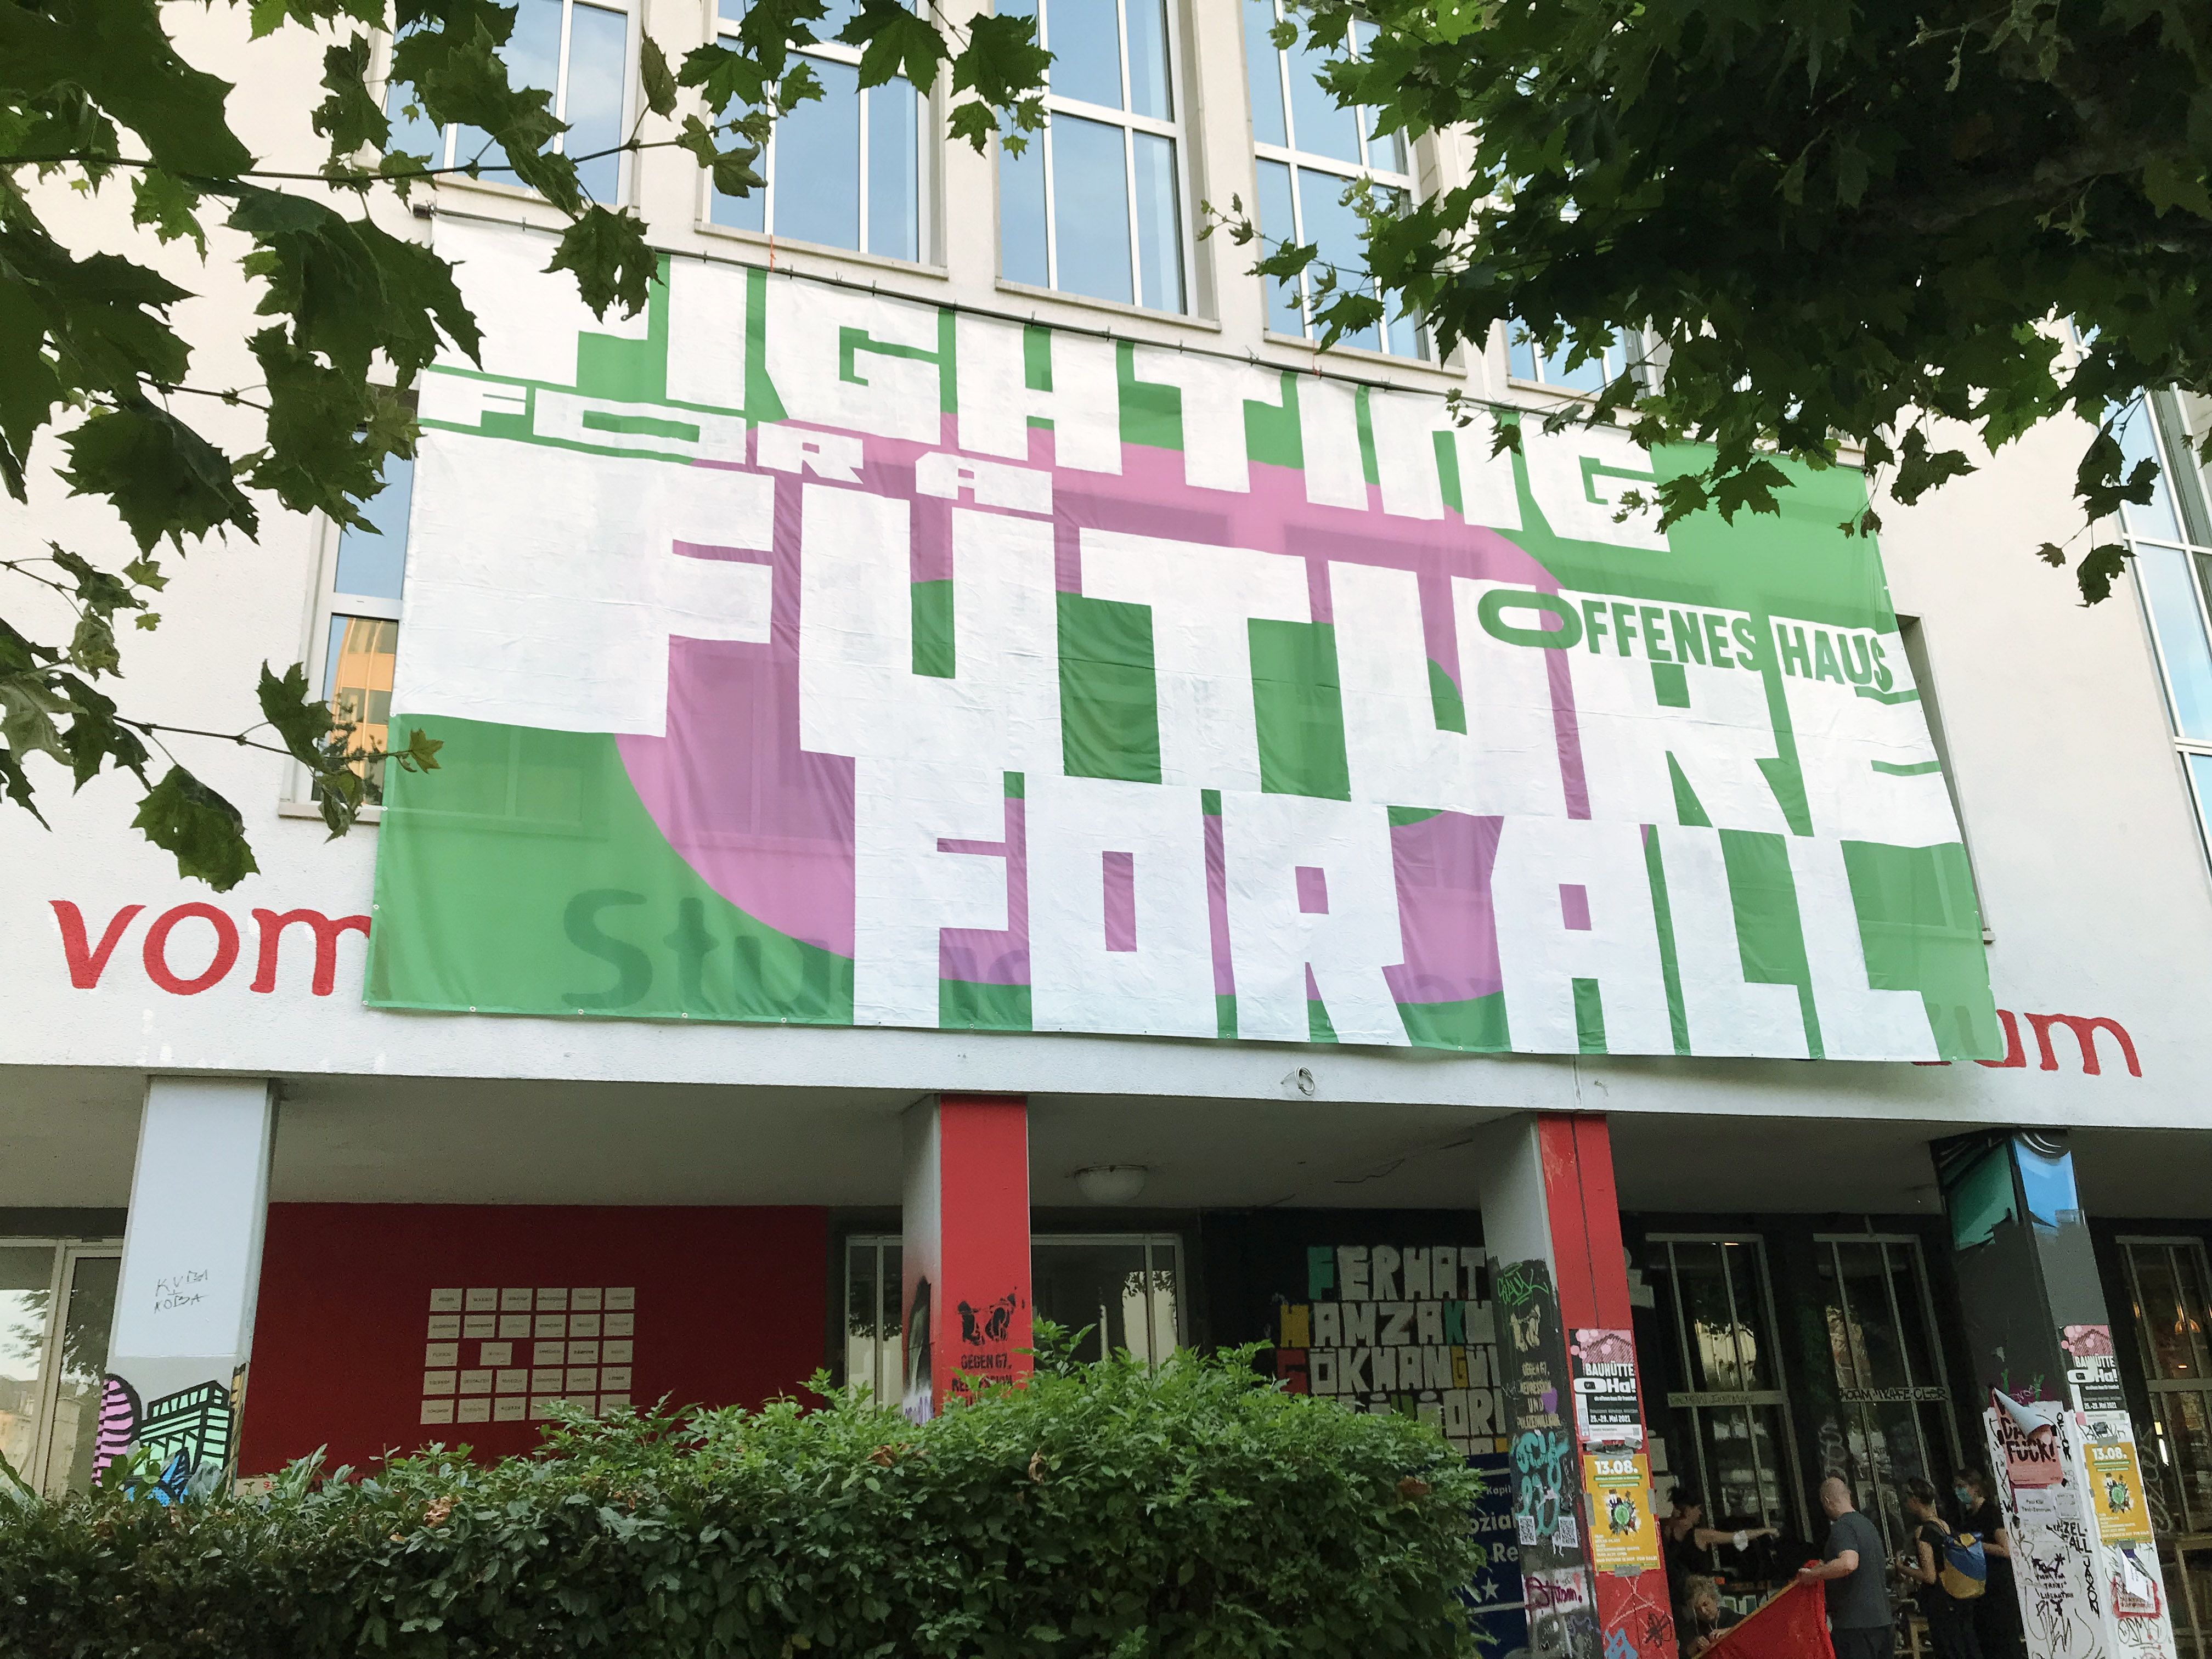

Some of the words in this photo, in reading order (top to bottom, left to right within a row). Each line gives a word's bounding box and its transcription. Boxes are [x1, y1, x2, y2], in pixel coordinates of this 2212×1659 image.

[417, 369, 864, 484] FOR
[915, 451, 1053, 515] A
[393, 437, 1961, 848] FUTURE
[1477, 589, 1758, 672] OFFENES
[1779, 624, 1893, 693] HAUS
[853, 757, 1413, 1047] FOR
[1490, 812, 1940, 1062] ALL
[48, 900, 371, 996] vom
[1307, 1245, 1485, 1300] FERHAT
[1585, 1361, 1635, 1377] BAUHÜTTE
[1618, 1414, 1632, 1423] 2021
[1594, 1459, 1639, 1475] 13.08.
[2006, 1437, 2056, 1464] FUCK!
[2091, 1446, 2128, 1460] 13.08.
